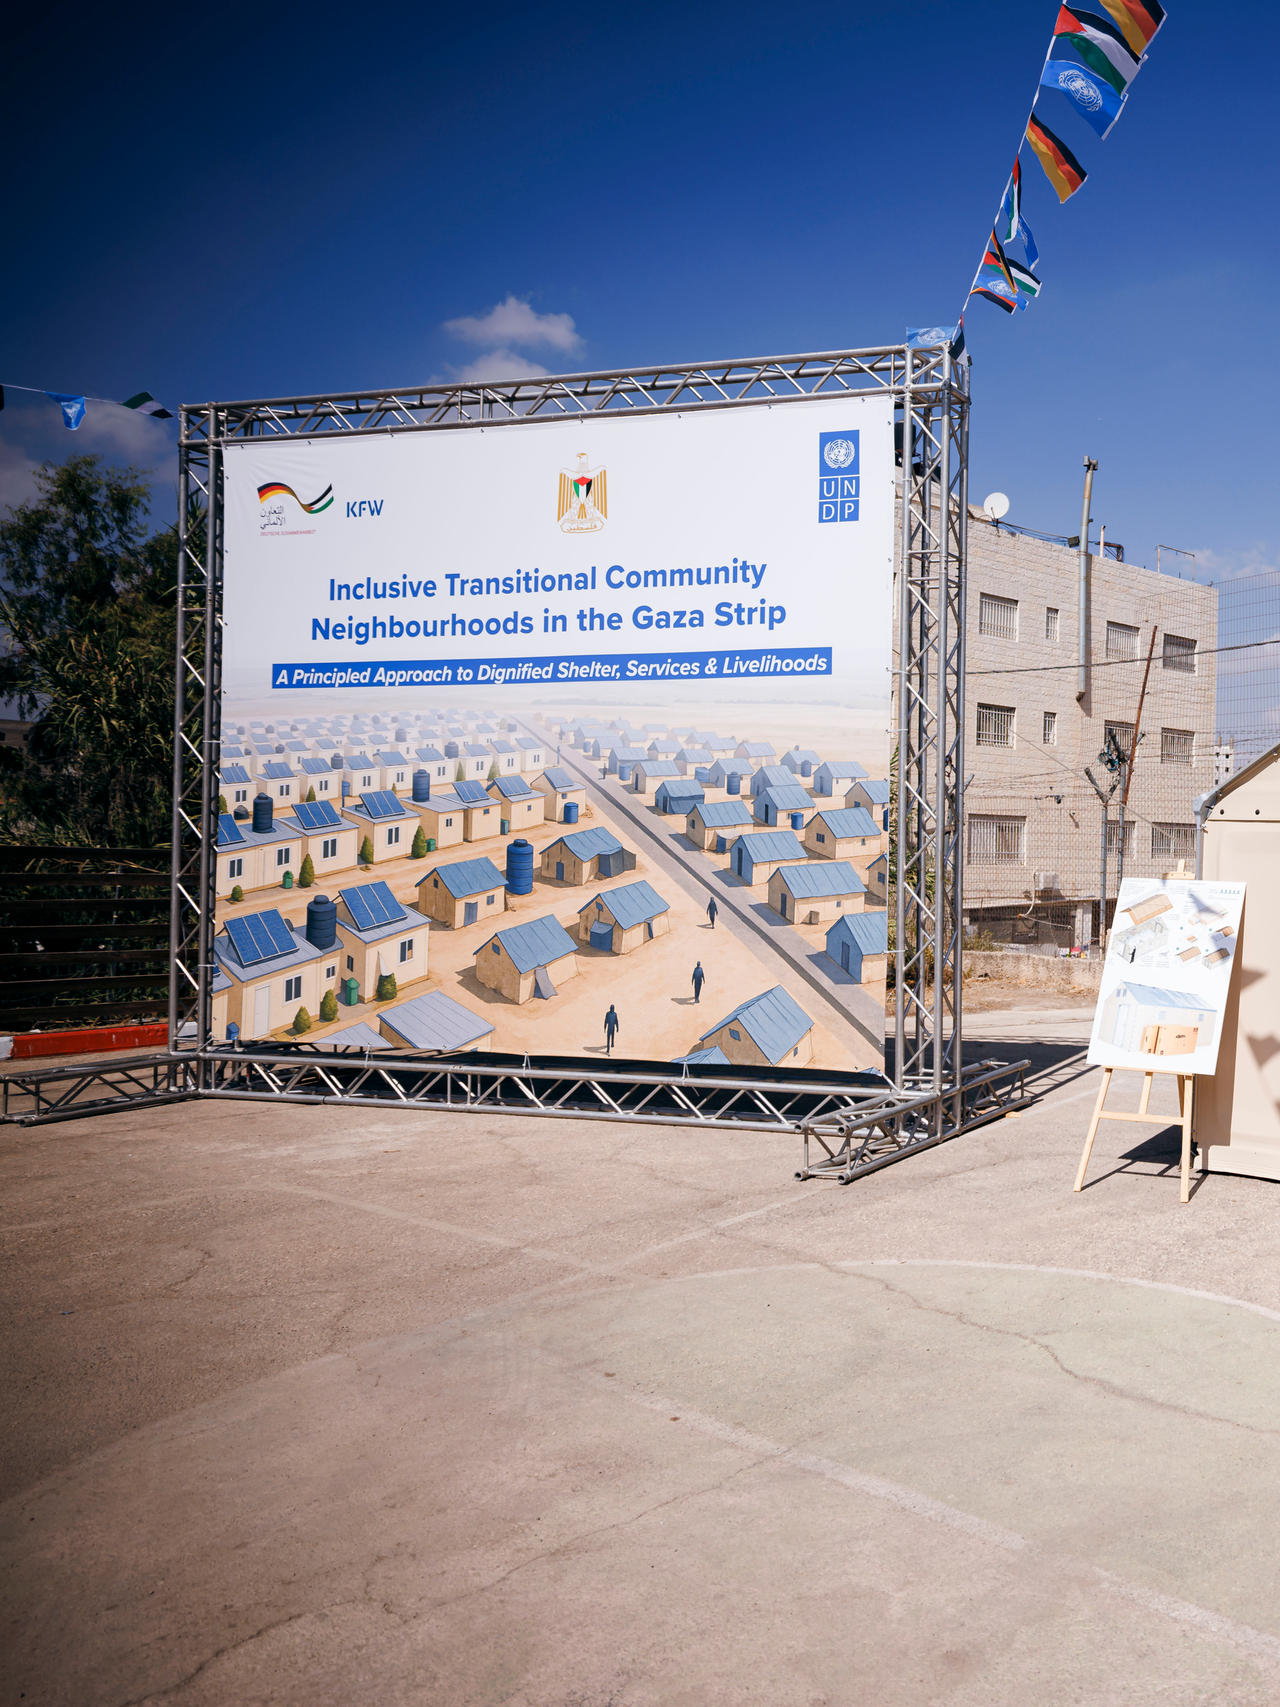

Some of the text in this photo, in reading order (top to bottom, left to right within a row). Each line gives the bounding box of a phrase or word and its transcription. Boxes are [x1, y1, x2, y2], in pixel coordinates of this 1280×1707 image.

[346, 499, 384, 518] KFW
[329, 557, 767, 601] Inclusive Transitional Community
[311, 598, 787, 646] Neighbourhoods in the Gaza Strip
[276, 654, 828, 687] A Principled Approach to Dignified Shelter, Services & Livelihoods
